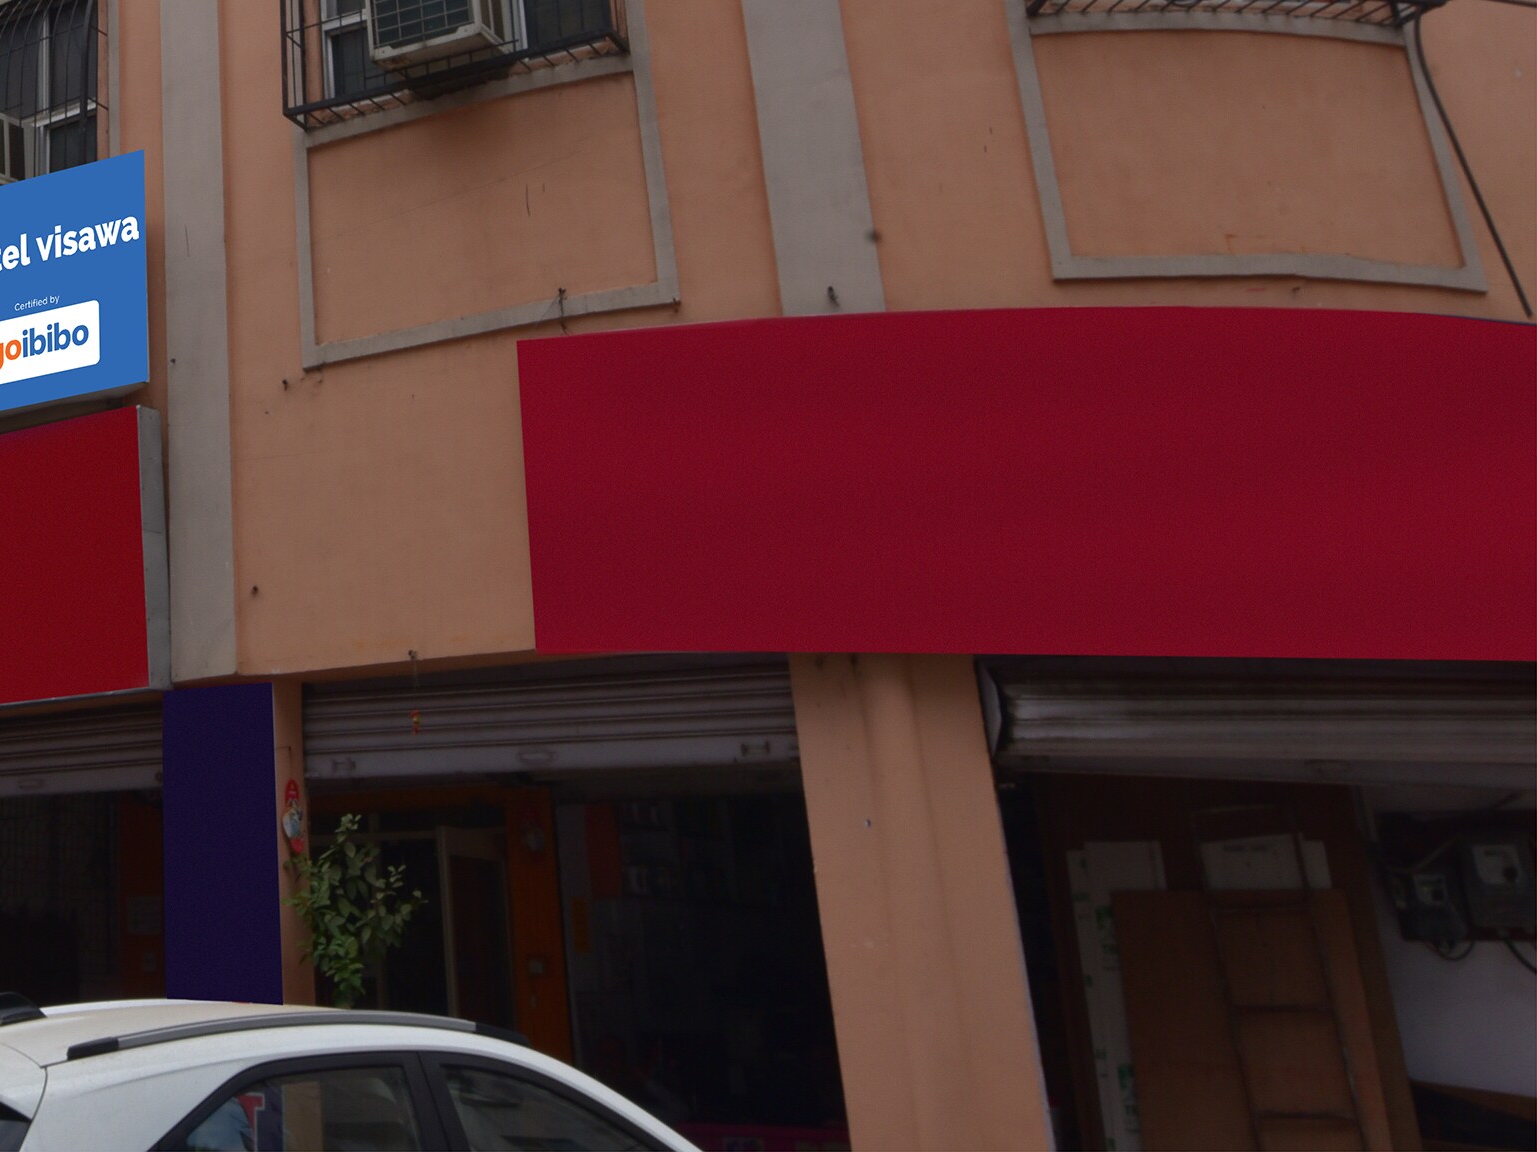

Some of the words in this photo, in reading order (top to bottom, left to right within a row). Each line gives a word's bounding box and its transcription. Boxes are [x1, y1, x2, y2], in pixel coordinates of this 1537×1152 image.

[36, 215, 140, 261] visawa
[13, 297, 48, 312] Certified
[49, 295, 61, 305] by
